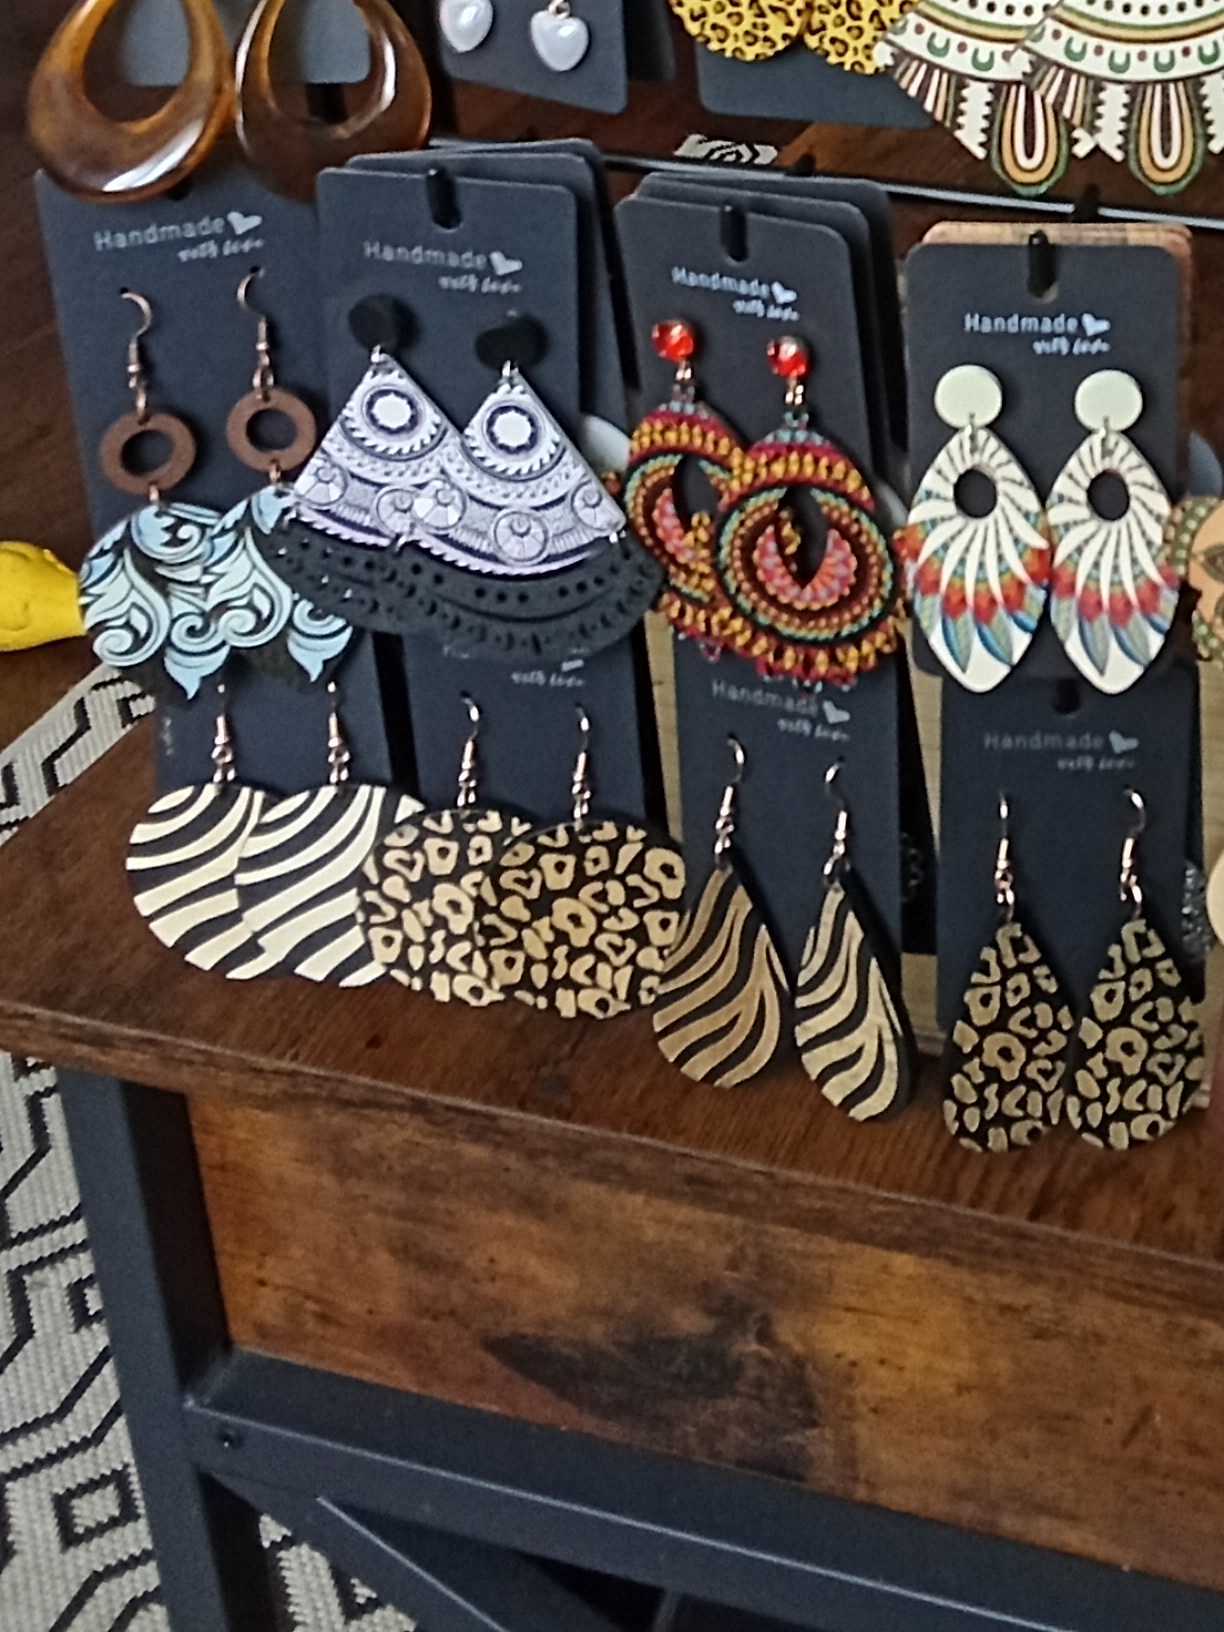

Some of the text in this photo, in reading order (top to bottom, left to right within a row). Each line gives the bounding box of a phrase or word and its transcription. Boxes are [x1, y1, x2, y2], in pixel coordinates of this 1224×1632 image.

[94, 216, 224, 250] Handmade
[363, 241, 486, 270] Handmade
[671, 266, 770, 297] Handmade
[964, 313, 1078, 334] Handmade
[712, 680, 819, 716] Handmade
[984, 730, 1104, 750] Handmade
